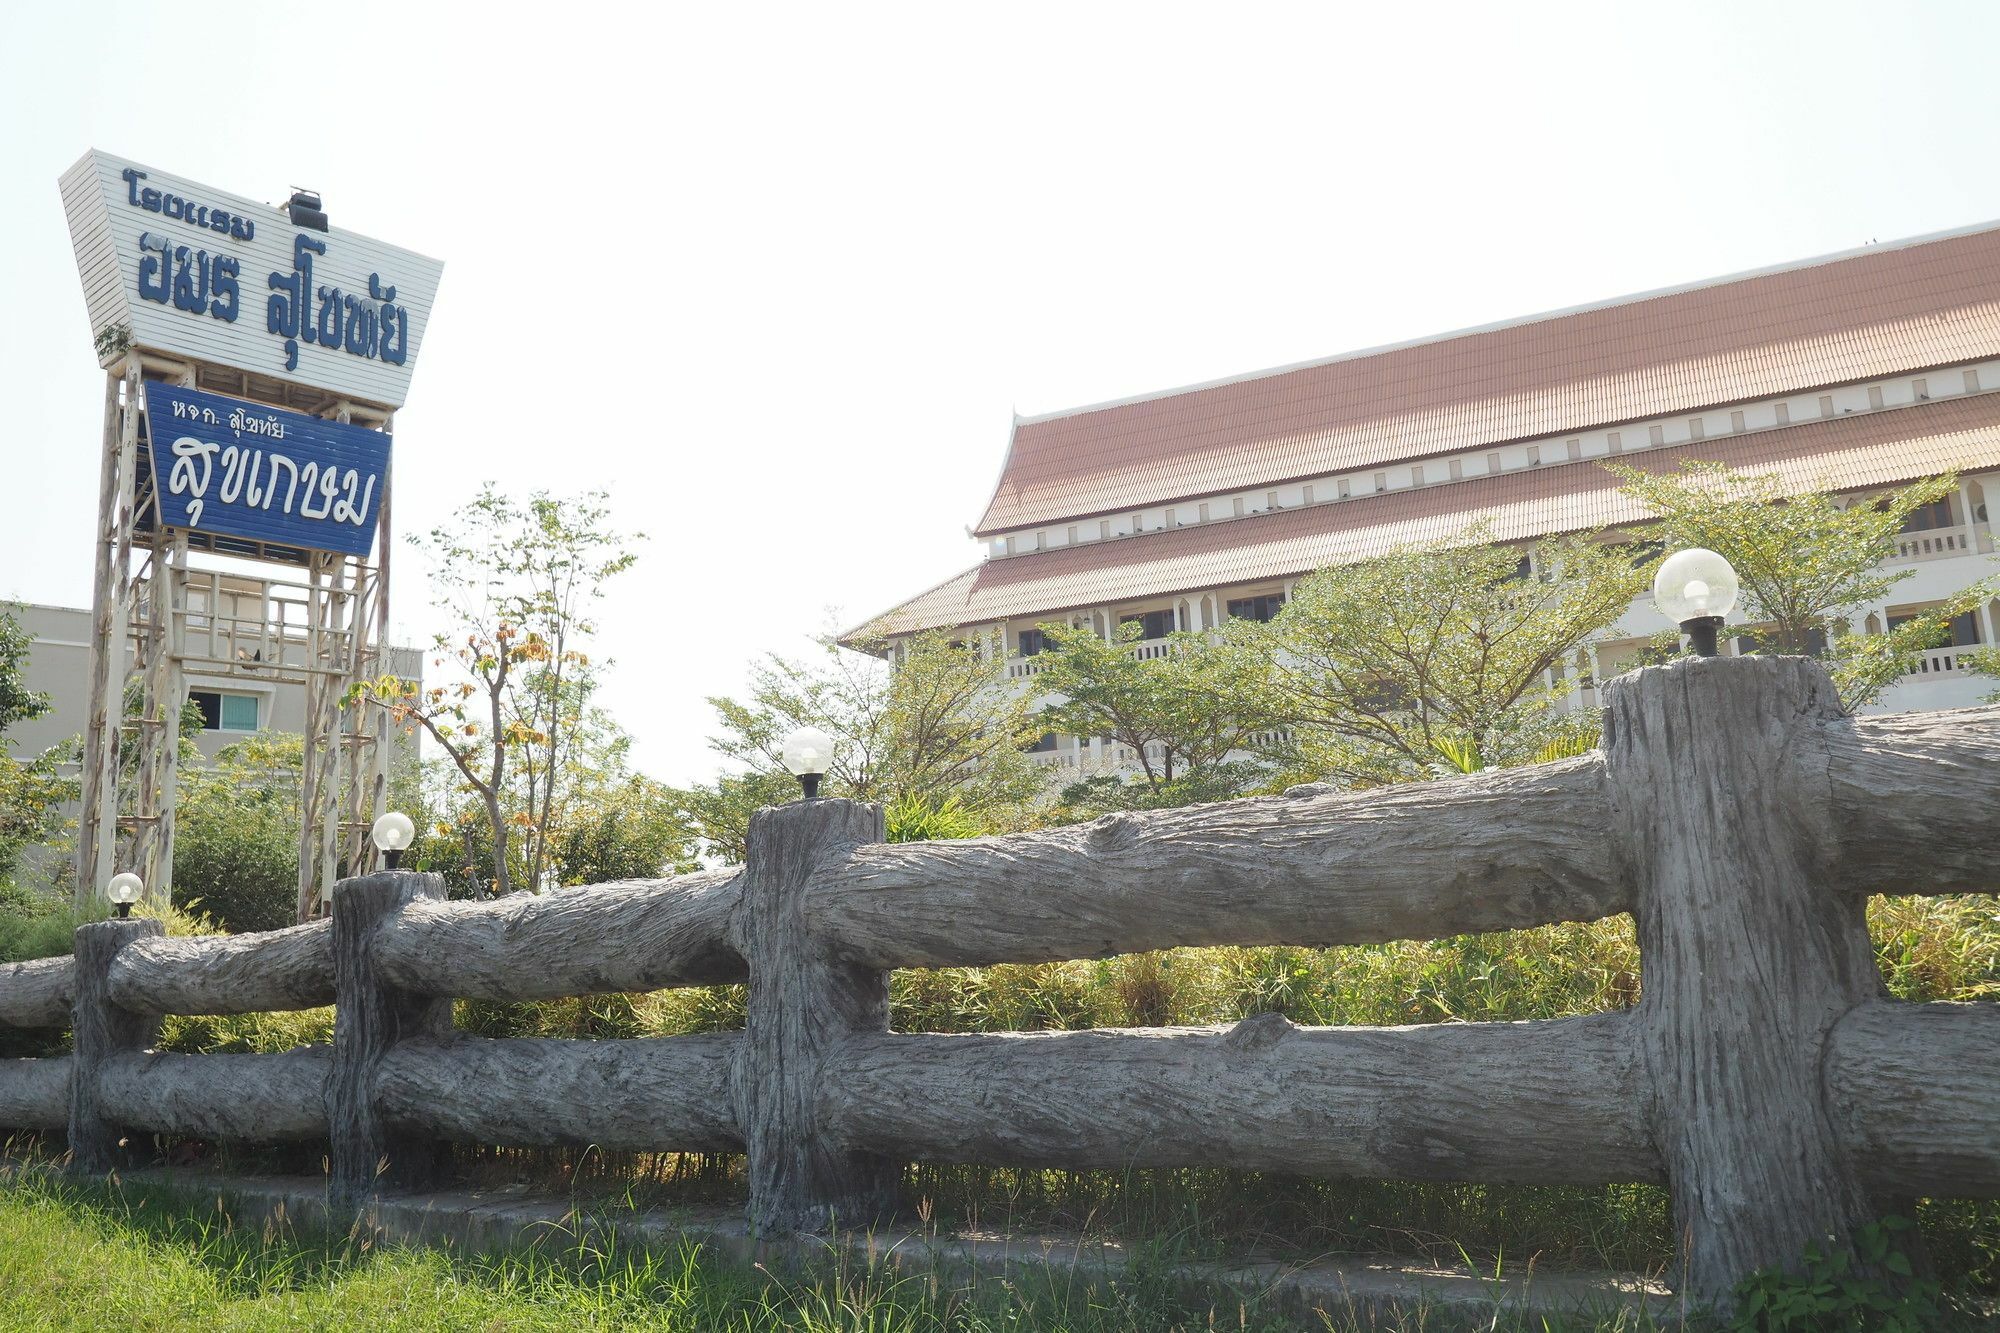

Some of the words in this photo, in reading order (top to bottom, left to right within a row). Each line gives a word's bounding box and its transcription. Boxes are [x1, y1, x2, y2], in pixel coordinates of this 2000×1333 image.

[122, 167, 255, 242] โรงแรม
[138, 231, 240, 323] อมร
[267, 233, 407, 372] สุโขทัย
[229, 407, 284, 439] สุโขทัย
[169, 436, 376, 527] สุขเกษม
